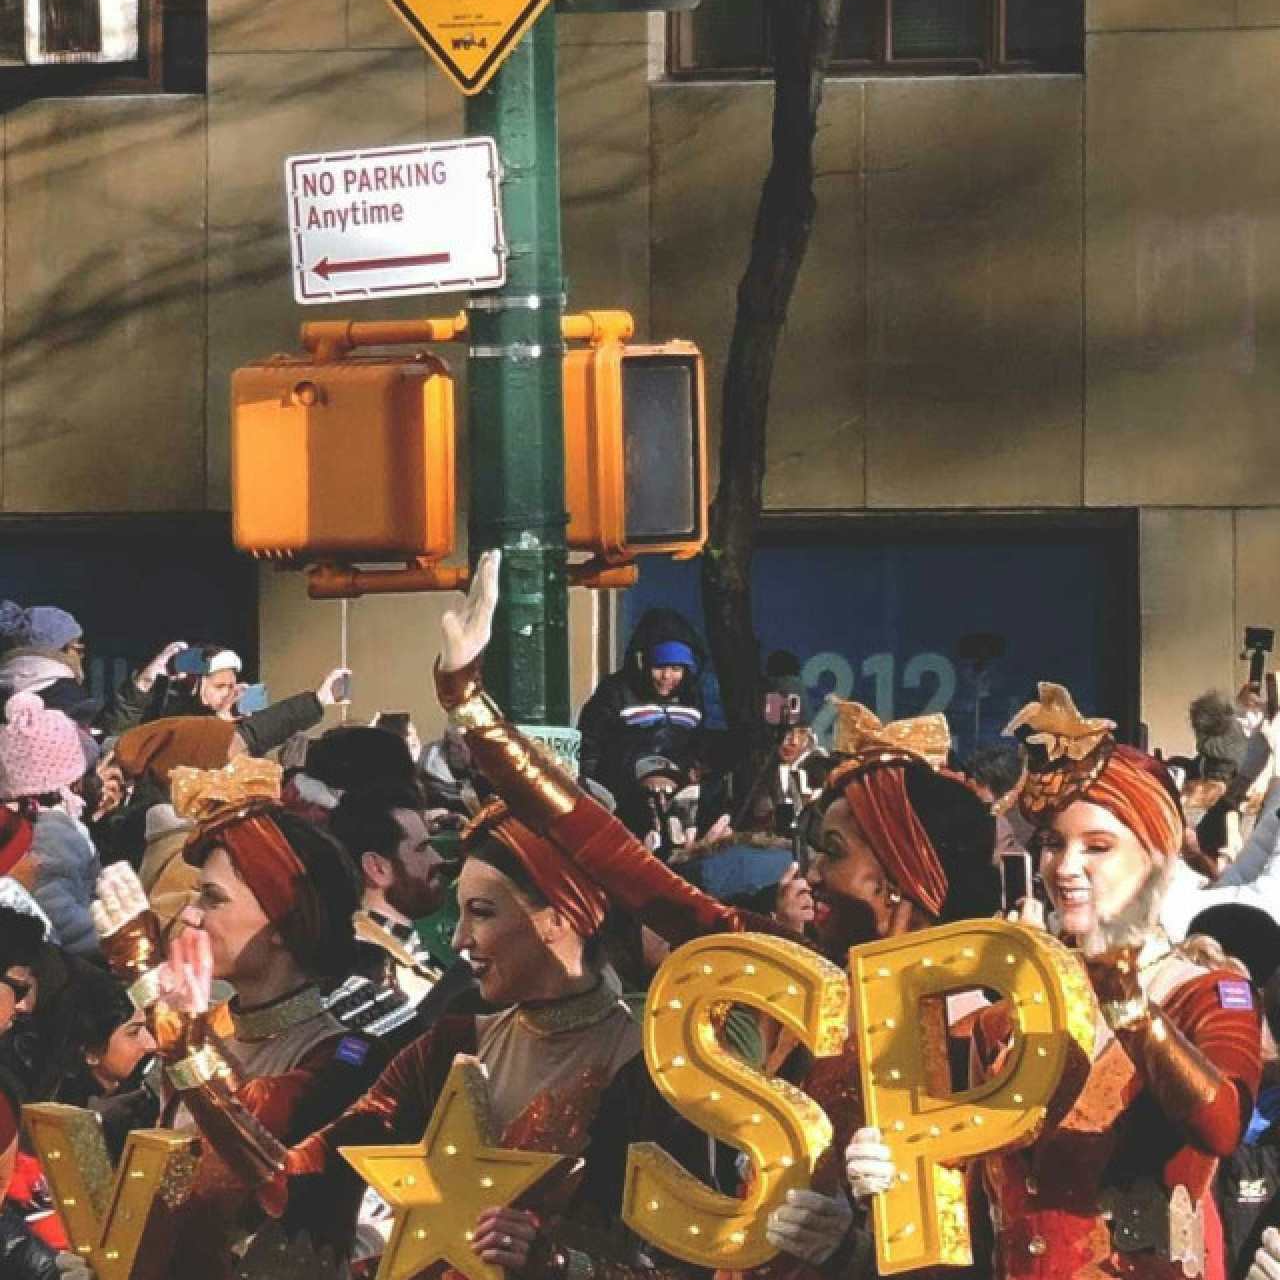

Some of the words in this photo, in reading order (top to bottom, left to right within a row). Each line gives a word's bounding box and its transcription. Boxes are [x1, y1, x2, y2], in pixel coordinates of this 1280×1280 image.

[302, 171, 334, 198] NO
[343, 160, 447, 194] PARKING
[306, 200, 404, 233] Anytime
[801, 651, 957, 750] 212
